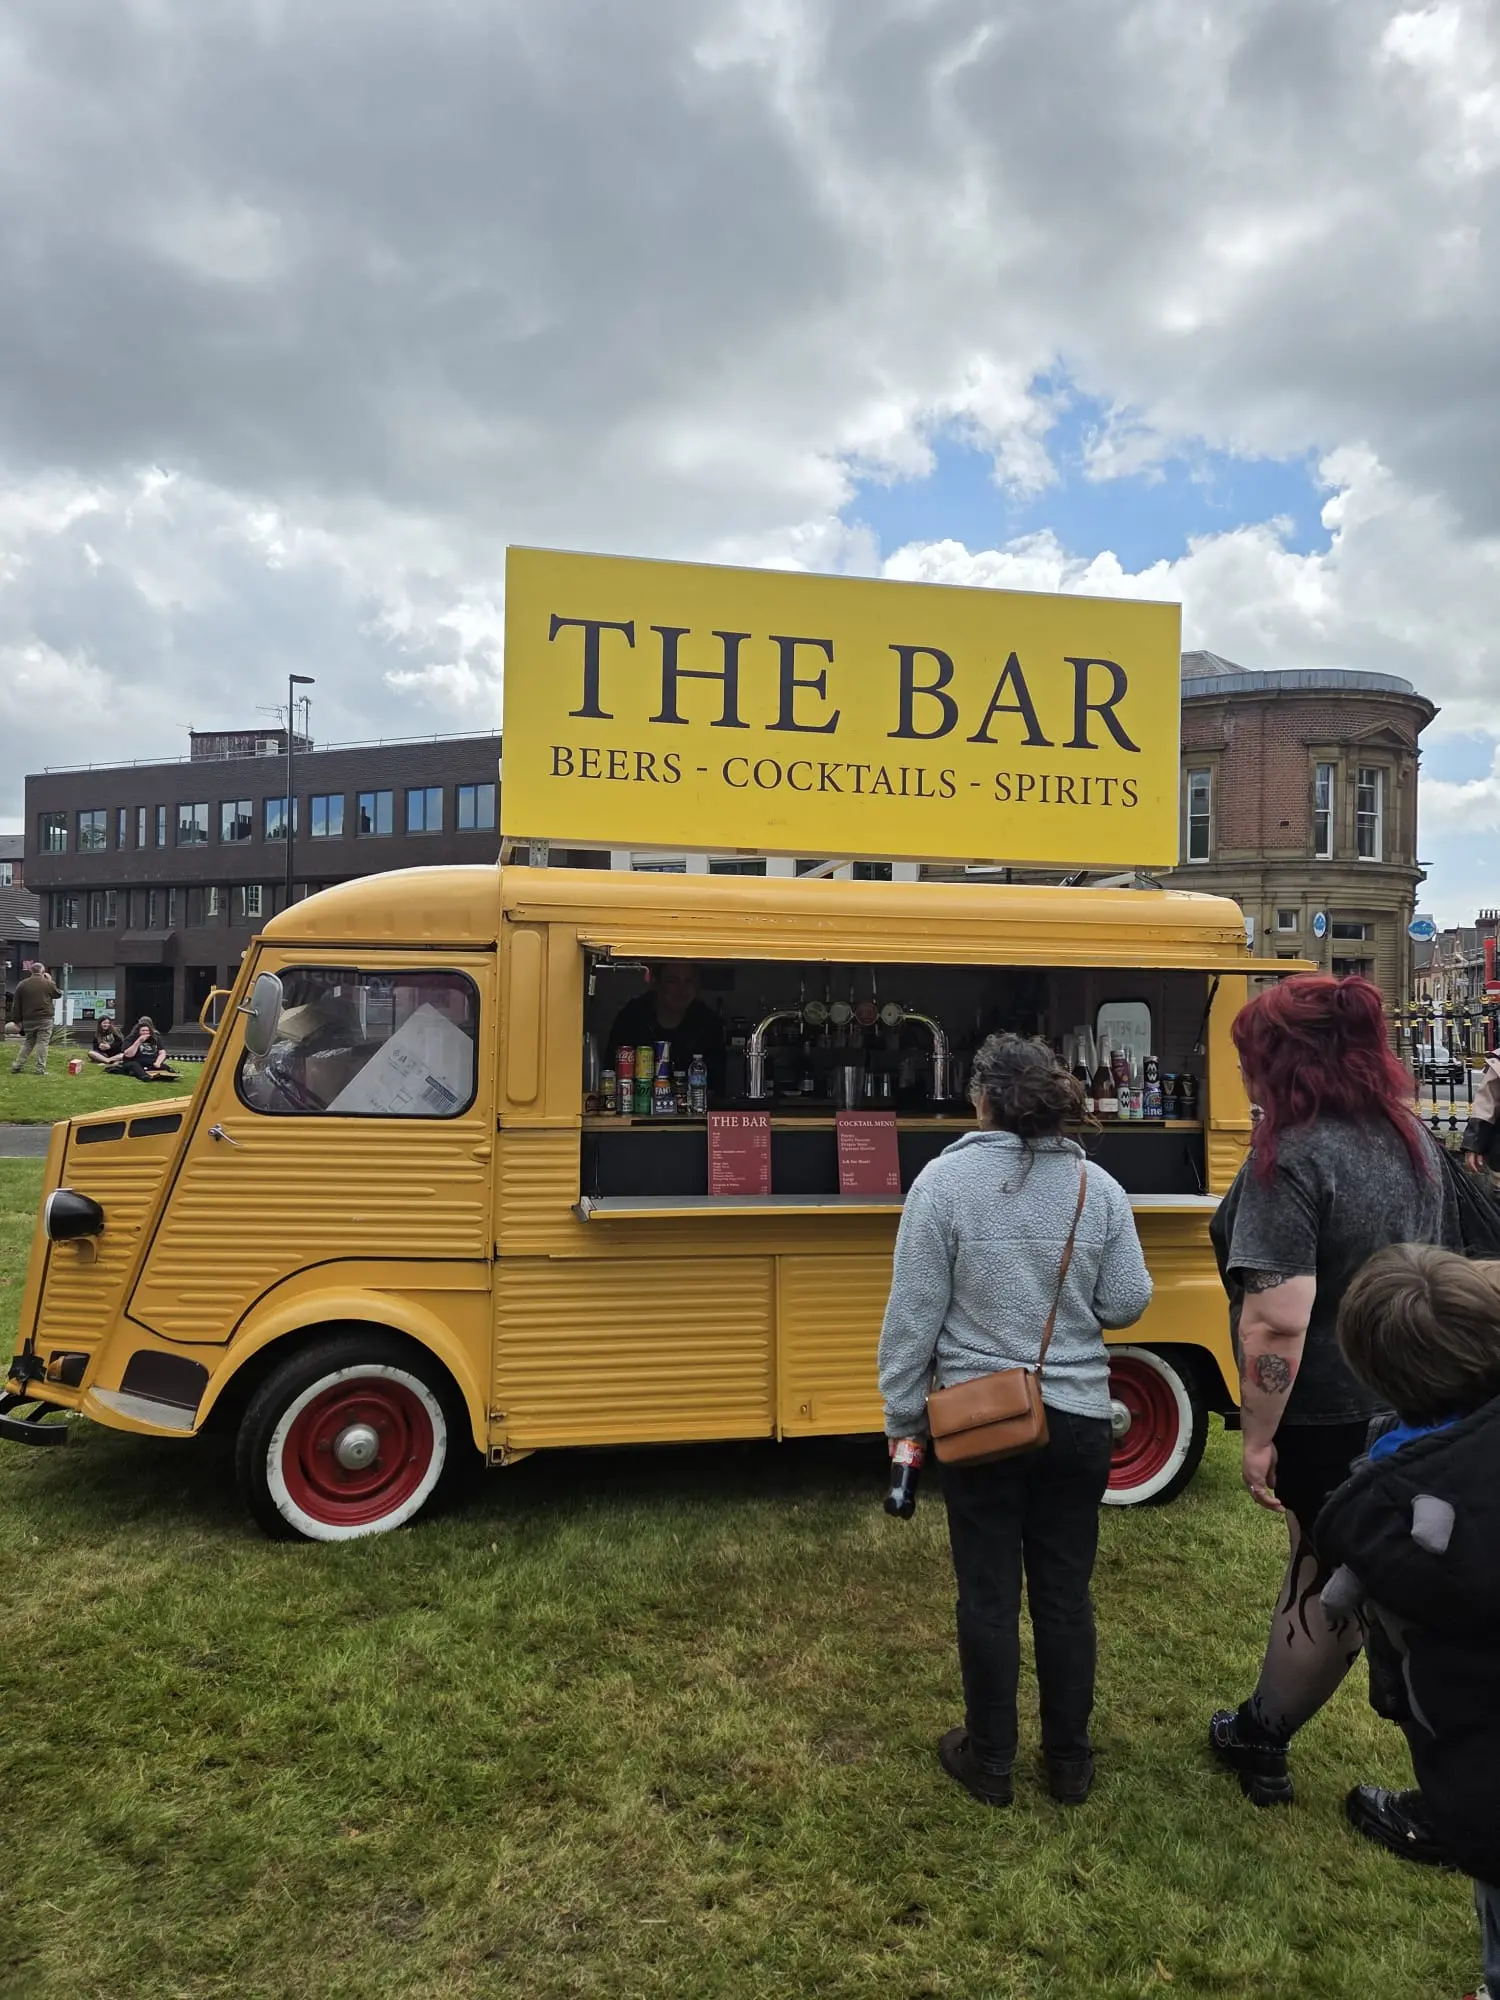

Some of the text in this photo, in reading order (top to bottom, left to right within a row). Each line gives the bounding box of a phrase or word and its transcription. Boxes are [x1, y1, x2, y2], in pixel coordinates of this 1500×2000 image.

[548, 613, 1141, 753] THE BAR
[549, 745, 681, 784] BEERS
[722, 757, 956, 799] COCKTAILS
[994, 772, 1138, 808] SPIRITS
[711, 1116, 768, 1127] THE BAR
